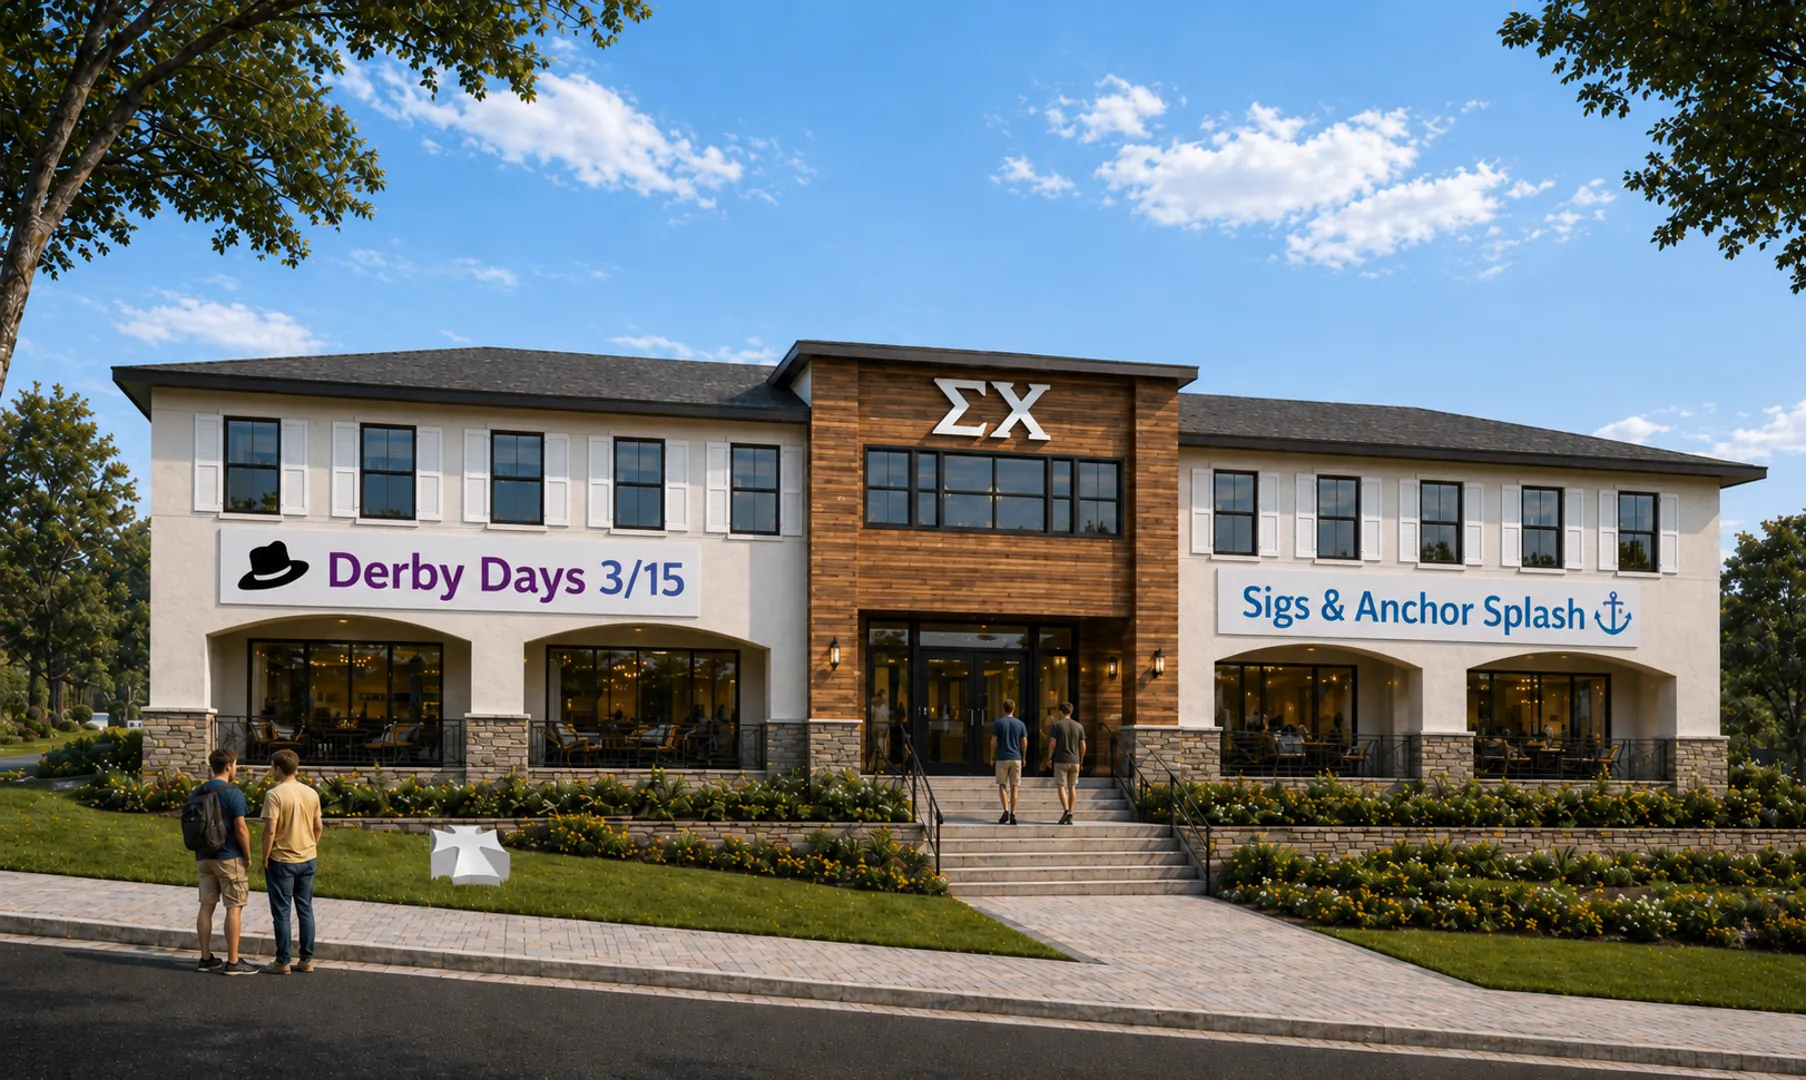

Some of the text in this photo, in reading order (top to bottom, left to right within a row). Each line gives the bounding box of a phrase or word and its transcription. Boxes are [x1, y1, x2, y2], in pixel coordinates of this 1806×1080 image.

[328, 551, 685, 604] Derby Days 3/15
[1242, 585, 1586, 636] Sigs & Anchor Splash
